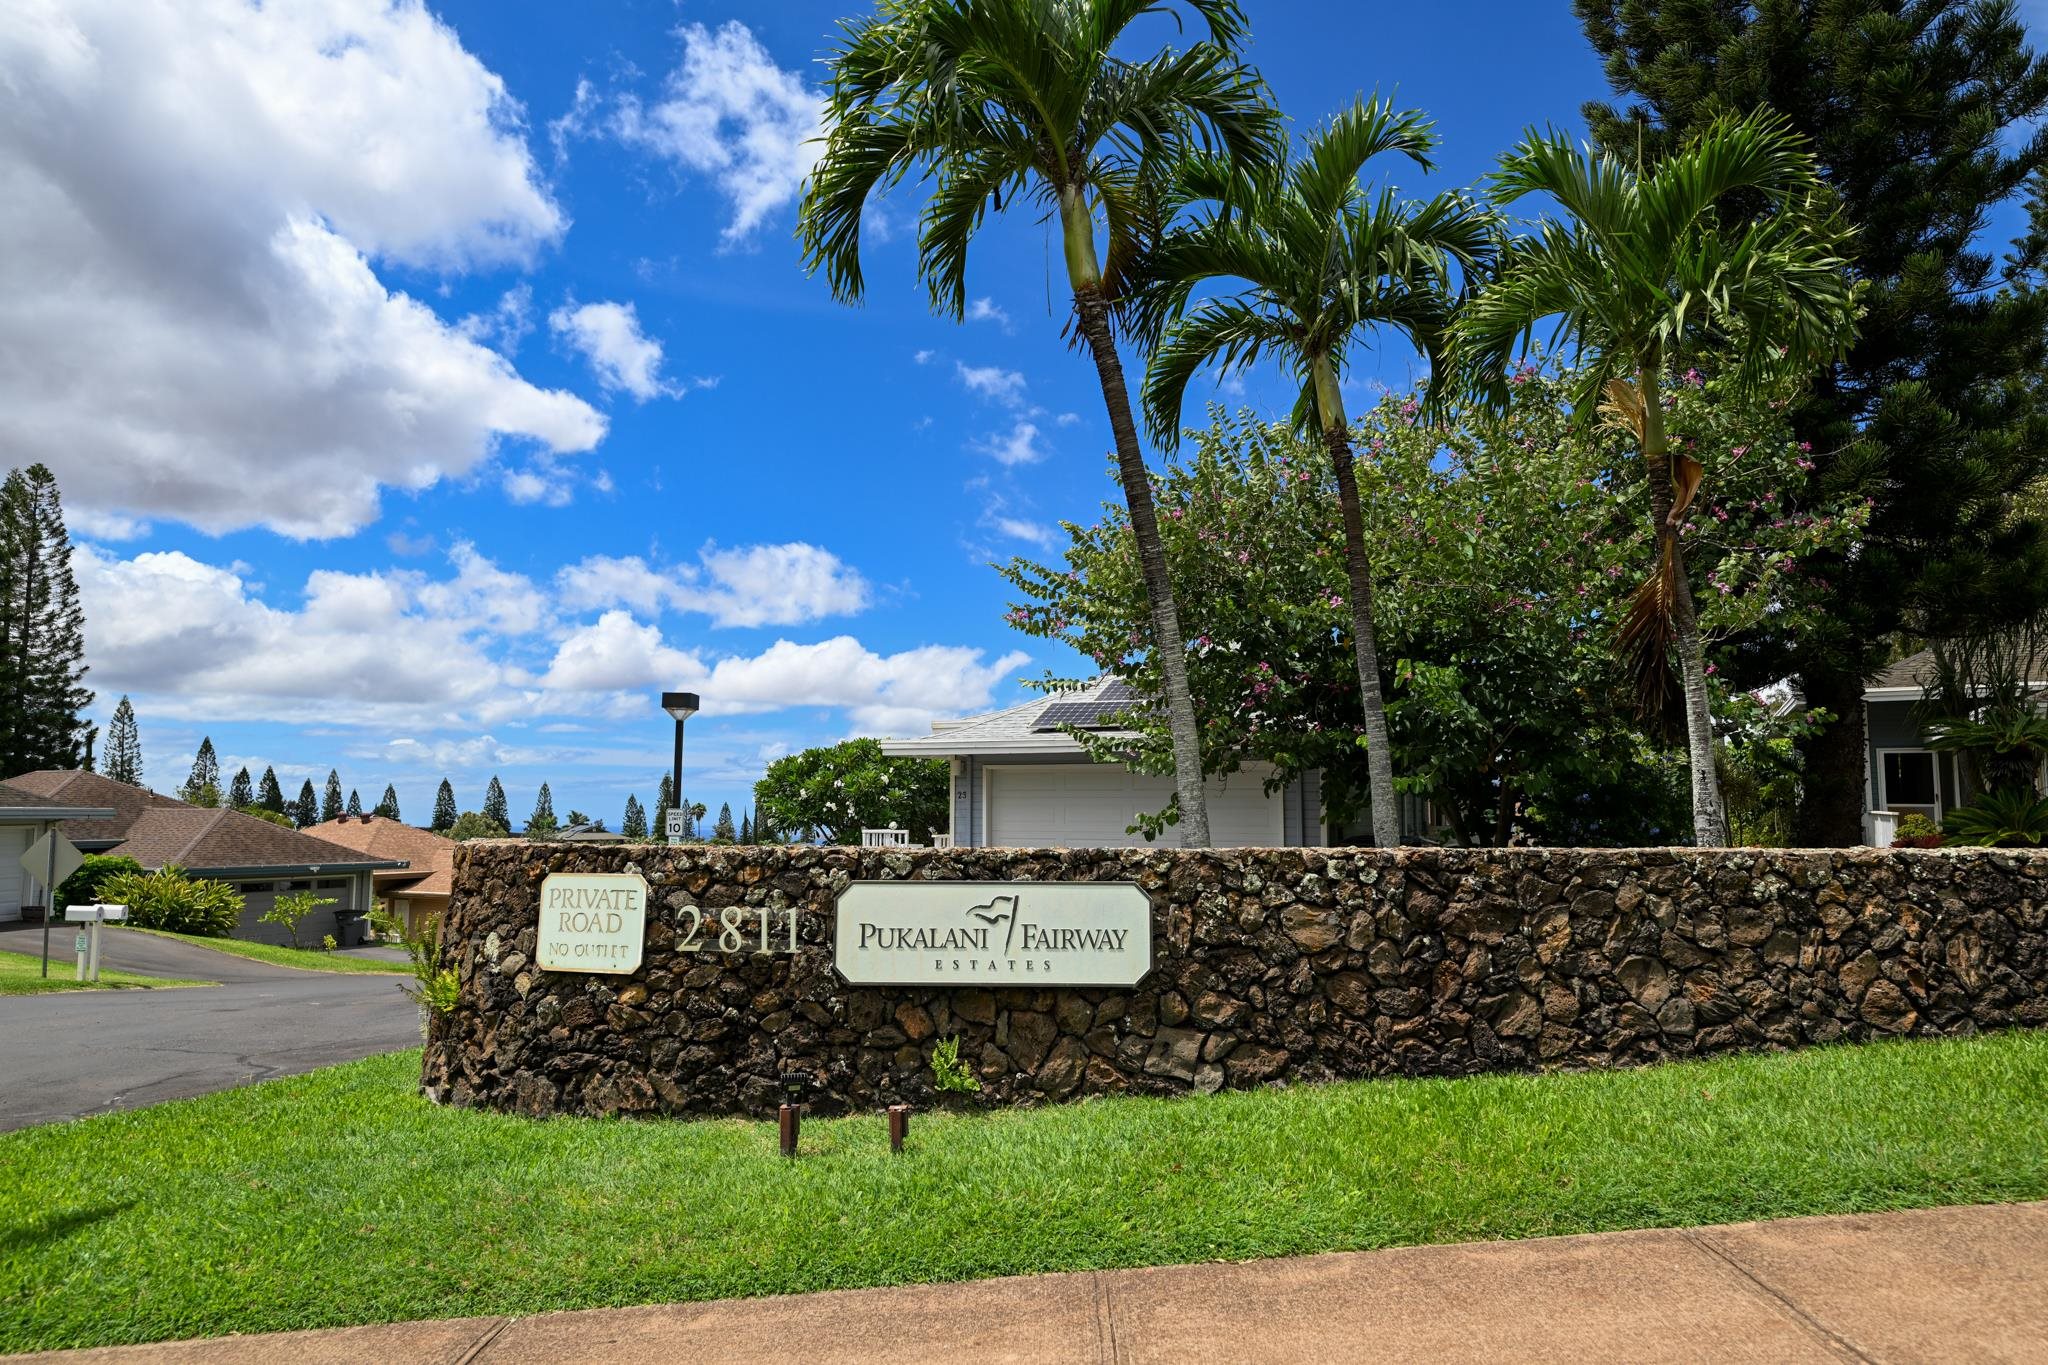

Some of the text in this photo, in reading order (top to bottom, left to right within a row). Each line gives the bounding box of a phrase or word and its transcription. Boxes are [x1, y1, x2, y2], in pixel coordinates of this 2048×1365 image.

[669, 823, 681, 833] 10
[548, 887, 638, 910] PRIVATE
[558, 912, 623, 934] ROAD
[675, 904, 802, 954] 2811
[858, 922, 1129, 951] PUKALANI FAIRWAY
[549, 942, 569, 957] NO
[935, 959, 1052, 971] ESTATES
